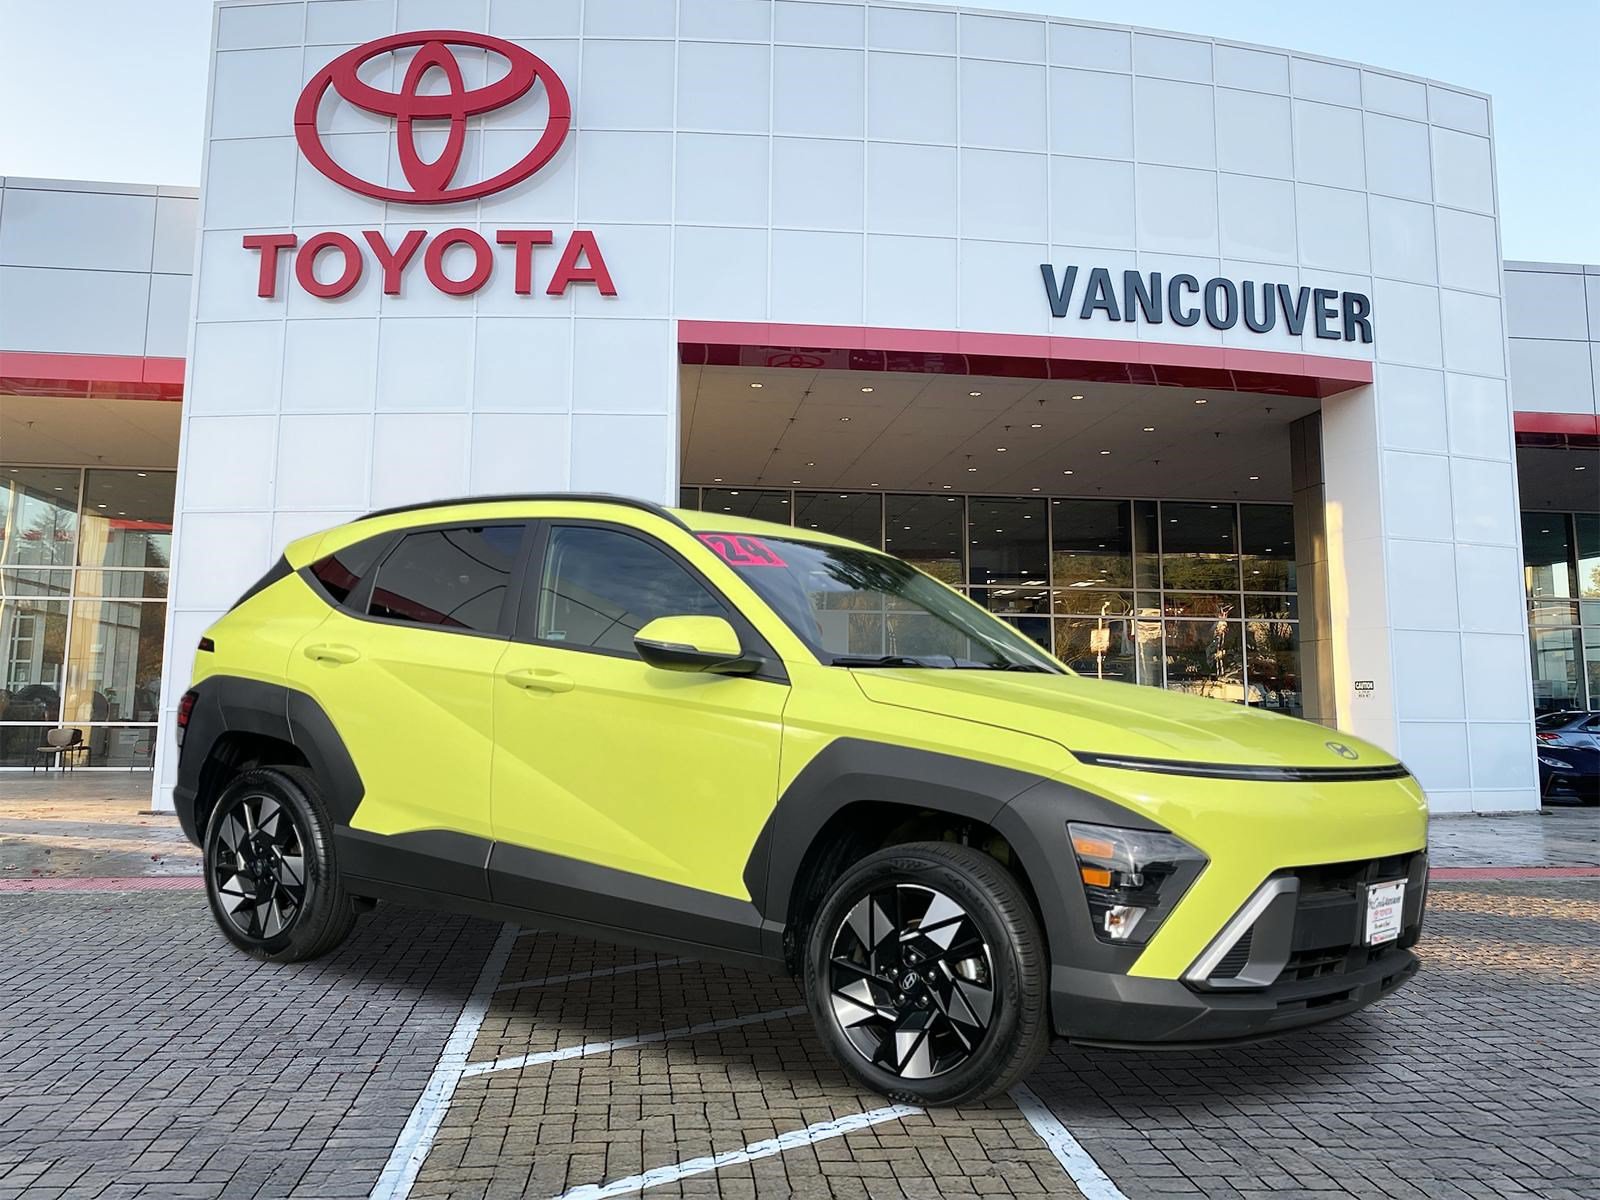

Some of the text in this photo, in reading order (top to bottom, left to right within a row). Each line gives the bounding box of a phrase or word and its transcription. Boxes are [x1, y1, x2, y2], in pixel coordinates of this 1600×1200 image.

[242, 227, 618, 299] TOYOTA
[1040, 263, 1373, 343] VANCOUVER
[705, 535, 774, 564] 24
